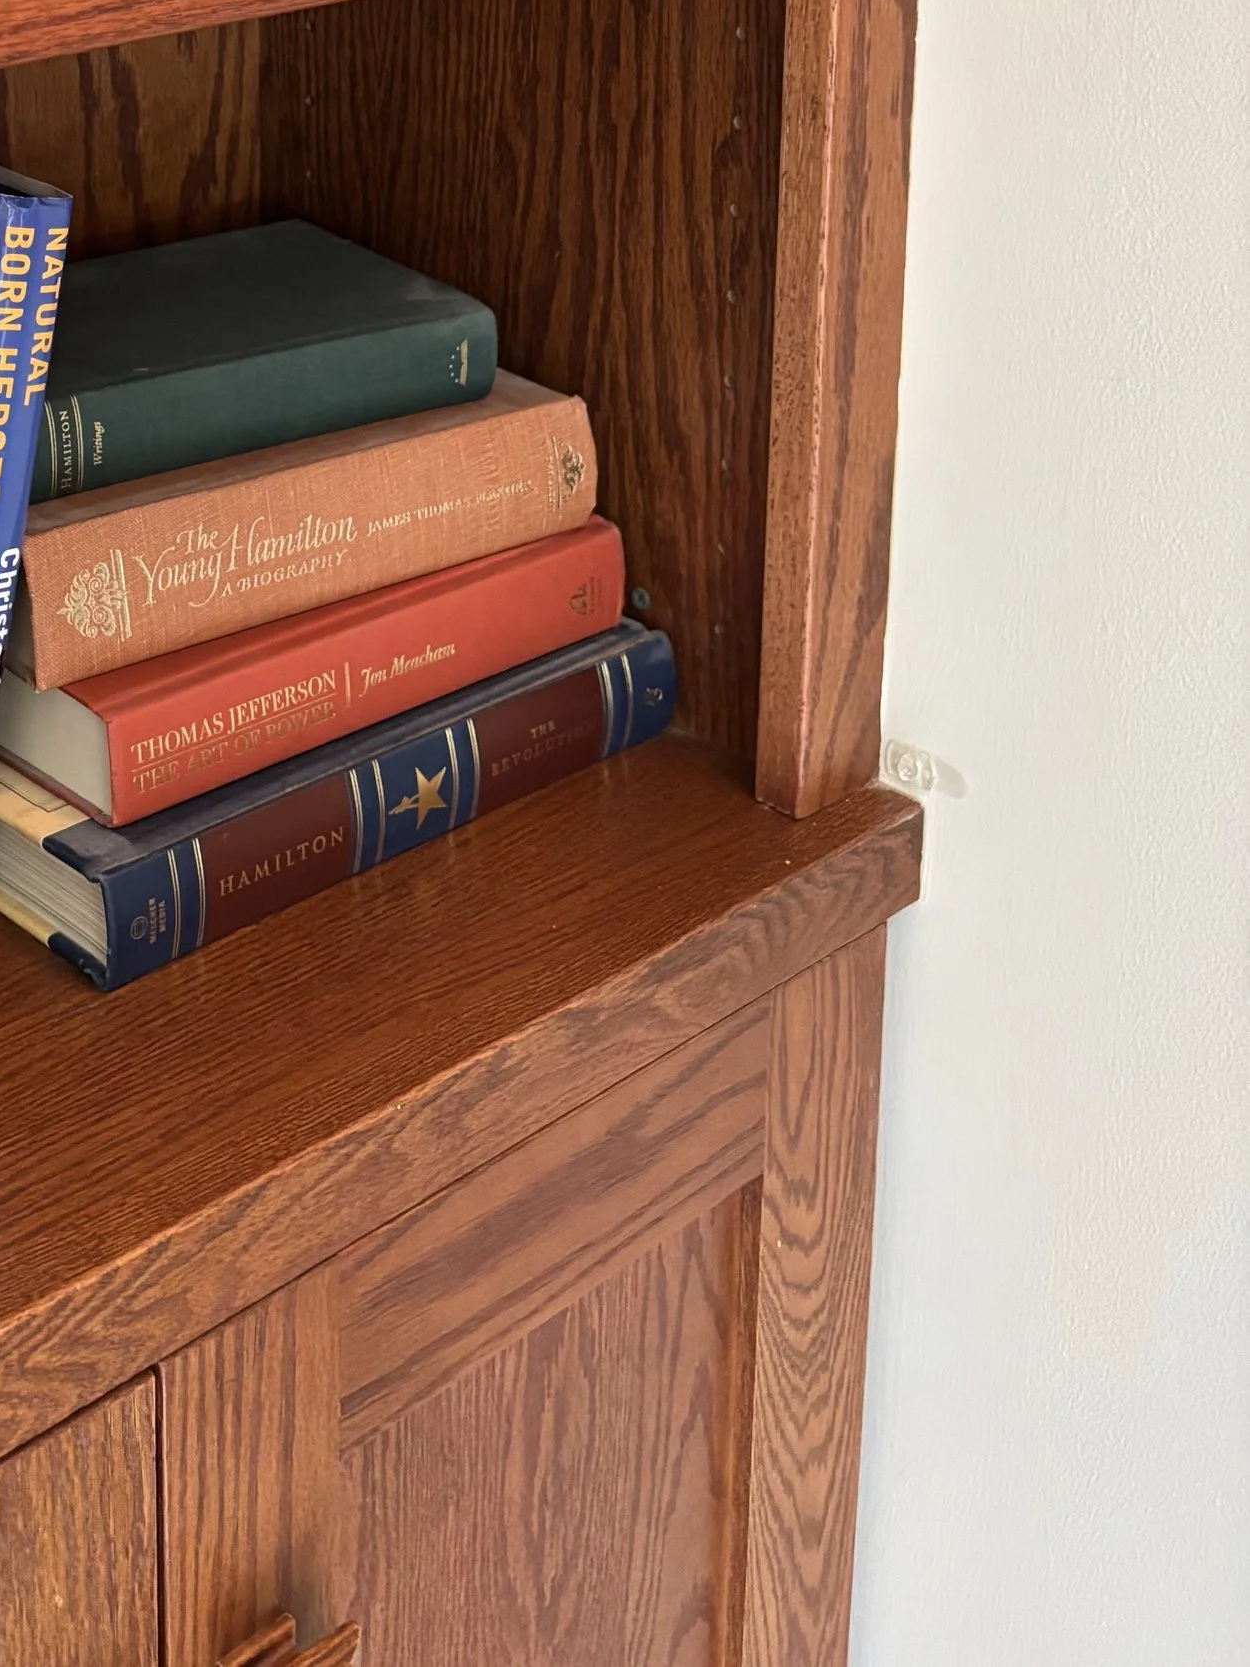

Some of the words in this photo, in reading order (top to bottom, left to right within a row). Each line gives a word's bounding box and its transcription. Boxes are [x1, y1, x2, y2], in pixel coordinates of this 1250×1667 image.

[24, 227, 69, 406] NATURAL
[59, 410, 72, 489] HAMILTON
[132, 545, 222, 608] Young
[224, 514, 357, 574] Hamilton
[177, 523, 223, 555] The
[358, 665, 387, 698] Jon
[389, 643, 456, 679] Meacham
[130, 712, 224, 765] THOMAS
[227, 670, 337, 735] JEFFERSON
[219, 826, 346, 898] HAMILTON
